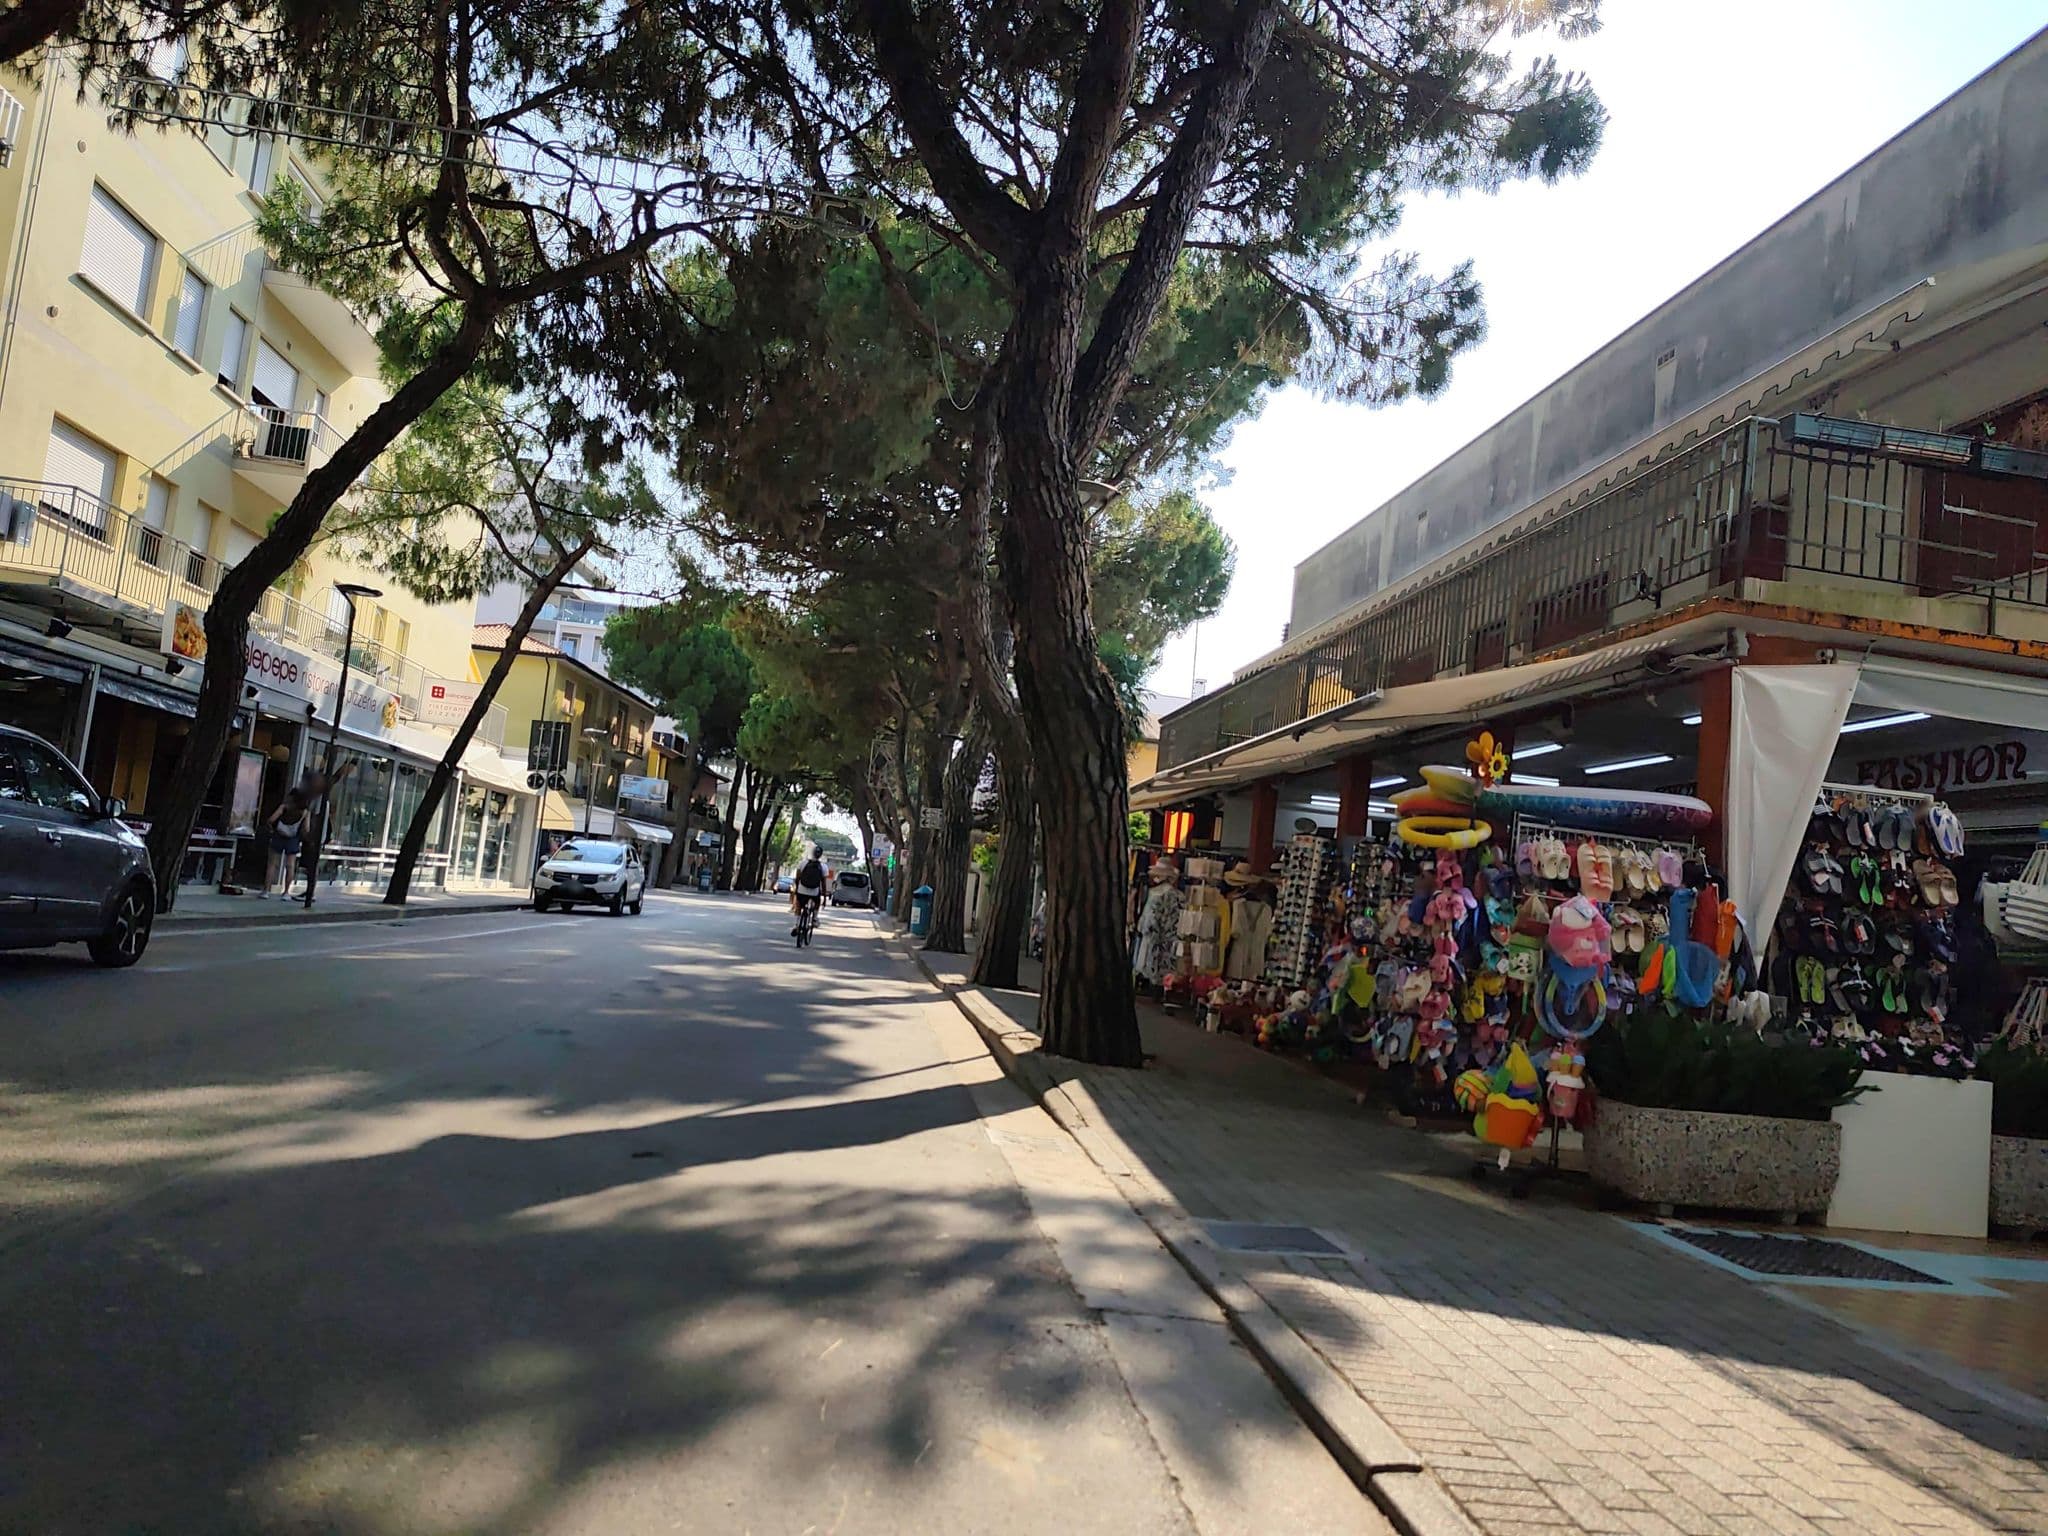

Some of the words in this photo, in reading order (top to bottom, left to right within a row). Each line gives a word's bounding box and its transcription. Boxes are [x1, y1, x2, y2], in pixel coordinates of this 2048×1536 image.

[244, 640, 298, 684] alepepe
[301, 670, 339, 698] ristorant
[1857, 741, 2027, 791] FASHION
